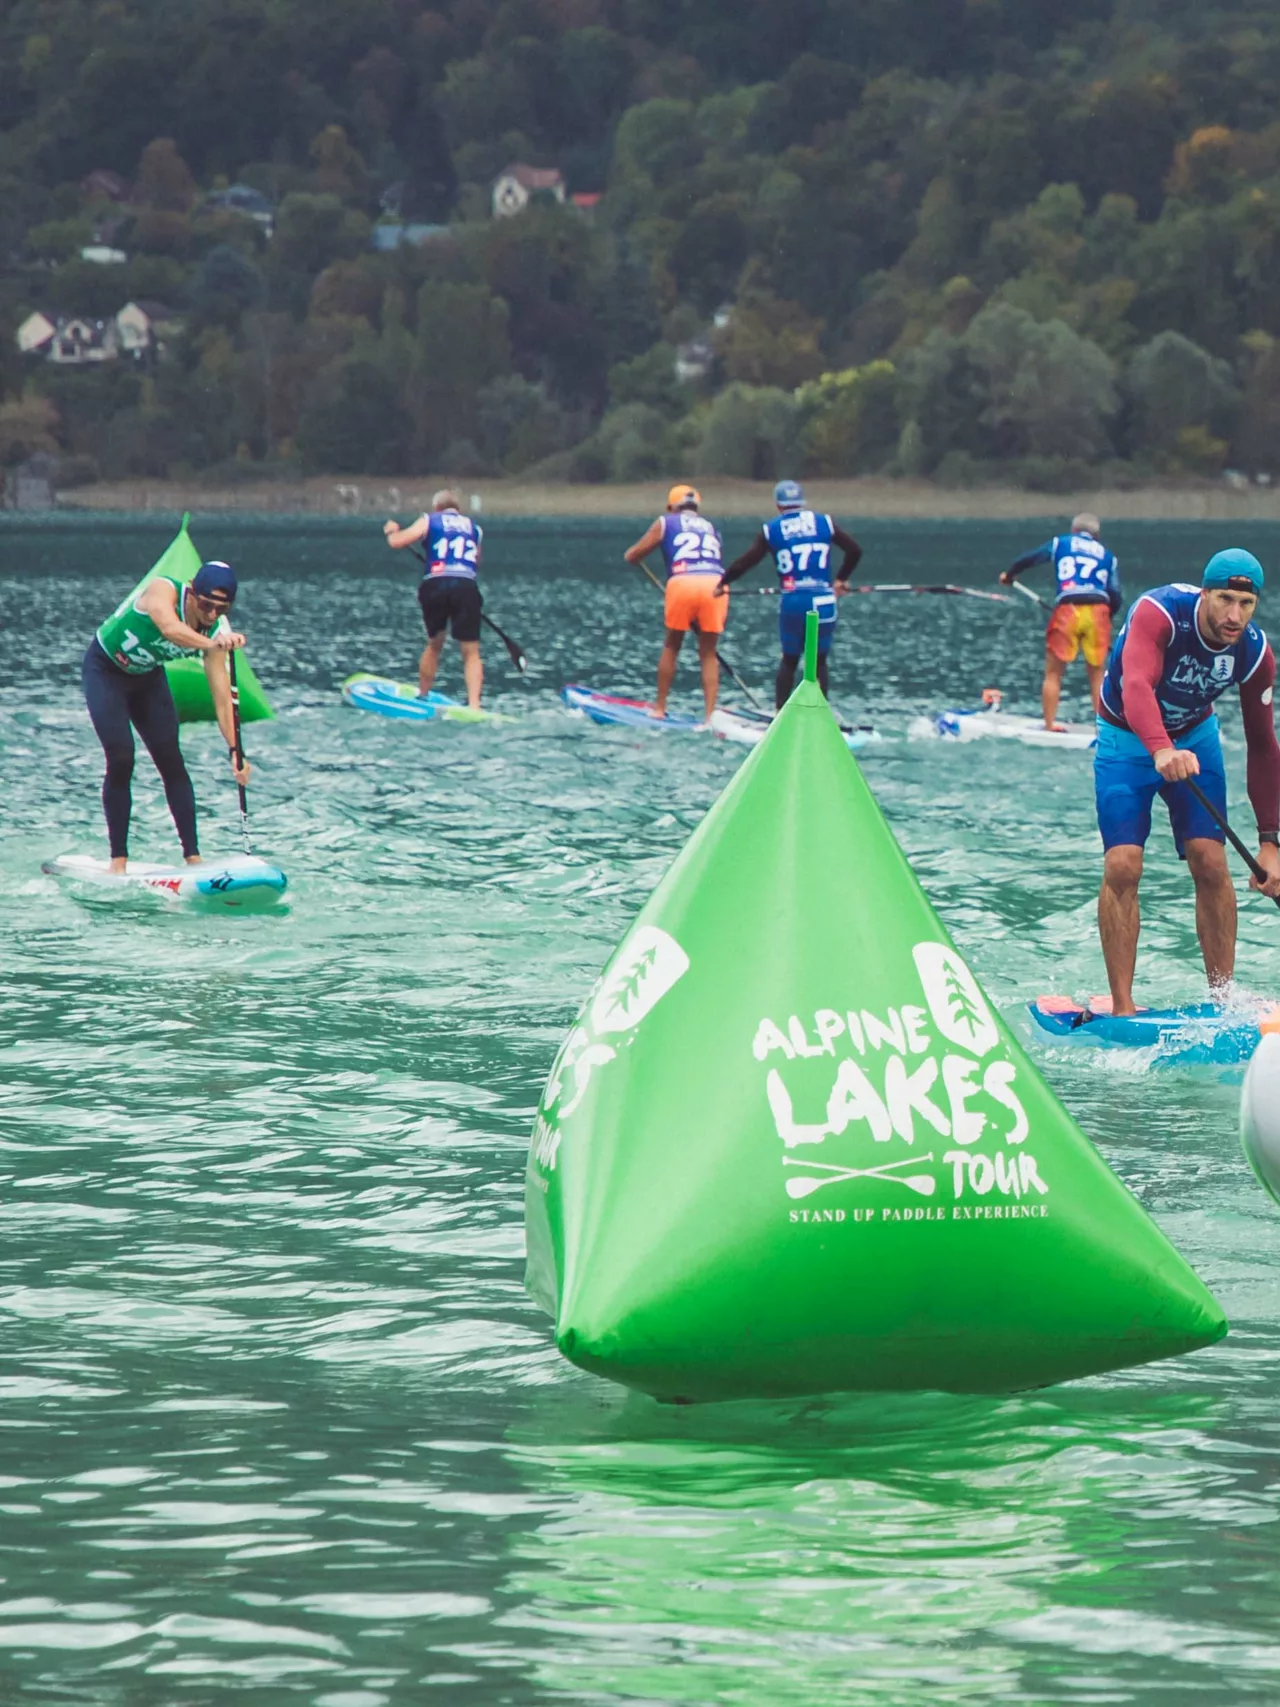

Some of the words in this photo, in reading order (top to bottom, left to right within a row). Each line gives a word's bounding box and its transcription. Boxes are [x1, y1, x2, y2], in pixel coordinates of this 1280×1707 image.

[432, 535, 477, 563] 112
[777, 542, 829, 574] 877
[753, 1005, 931, 1061] ALPINE
[766, 1054, 1030, 1148] LAKES
[942, 1150, 1049, 1200] TOUR
[789, 1208, 846, 1223] STAND
[853, 1208, 875, 1222] UP
[882, 1206, 946, 1221] PADDLE
[952, 1204, 1049, 1220] EXPERIENCE
